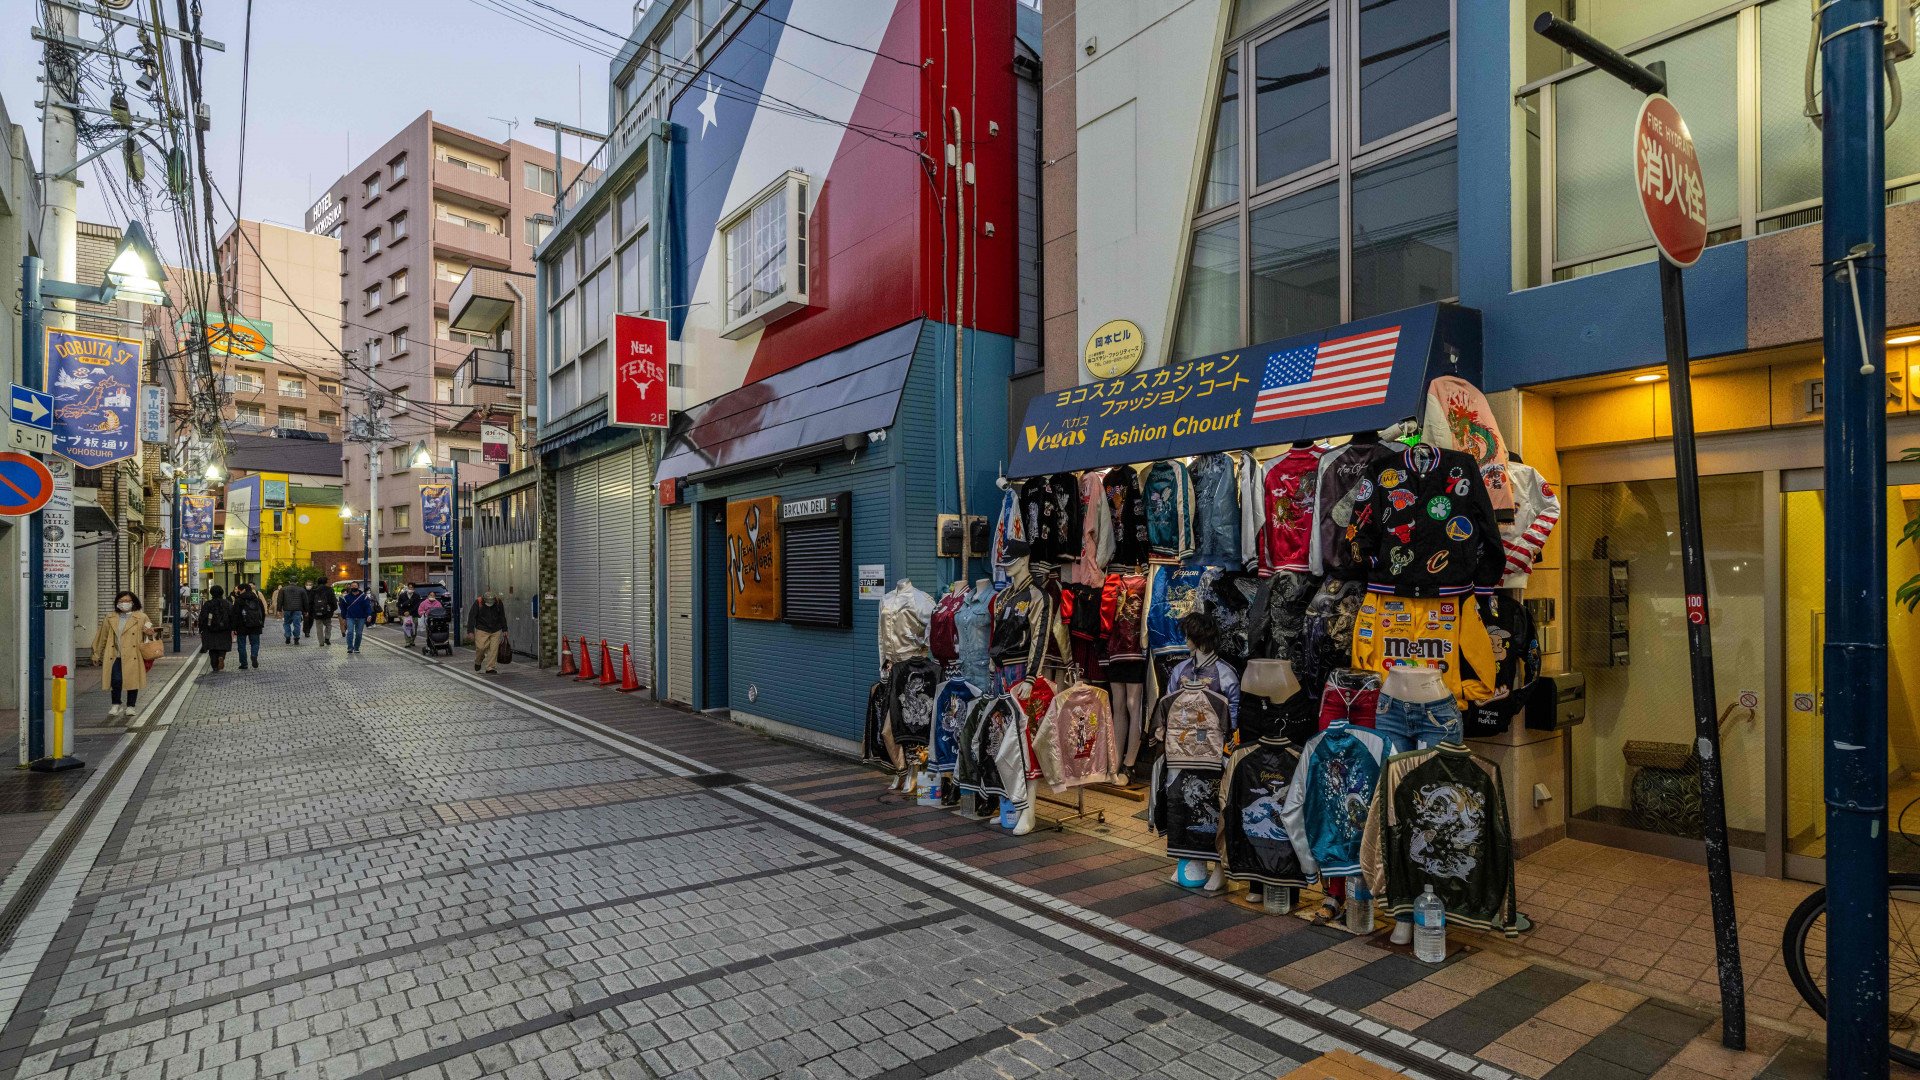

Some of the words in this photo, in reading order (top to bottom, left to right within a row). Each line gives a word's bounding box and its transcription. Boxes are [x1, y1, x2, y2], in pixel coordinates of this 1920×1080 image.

[1647, 111, 1663, 136] FIRE
[1665, 125, 1694, 159] HYDRANT
[1641, 133, 1706, 226] 消火栓
[313, 192, 333, 223] HOTEL
[630, 340, 654, 356] NEW
[1095, 329, 1131, 348] 岡本ビル
[54, 340, 113, 359] DOBUITA
[114, 349, 133, 366] ST
[620, 359, 665, 383] TEXAS
[1056, 379, 1125, 408] ヨコスカ
[1130, 354, 1240, 392] スカジャン
[1100, 384, 1193, 418] ファッション
[1197, 372, 1250, 398] コート
[650, 412, 665, 422] 2F
[16, 429, 46, 448] 5-17
[1026, 421, 1087, 453] Vegas
[1100, 424, 1167, 449] Fashion
[1173, 408, 1242, 437] Chourt
[53, 434, 128, 450] ドブ板通り
[67, 447, 113, 457] YOKOSUKA
[1445, 477, 1470, 496] 76
[784, 501, 809, 518] BRKLYN
[811, 498, 826, 512] DELI
[1431, 497, 1451, 510] CELTICS
[1172, 568, 1199, 580] Japan
[1687, 596, 1701, 607] 100
[1384, 637, 1452, 658] m&m's
